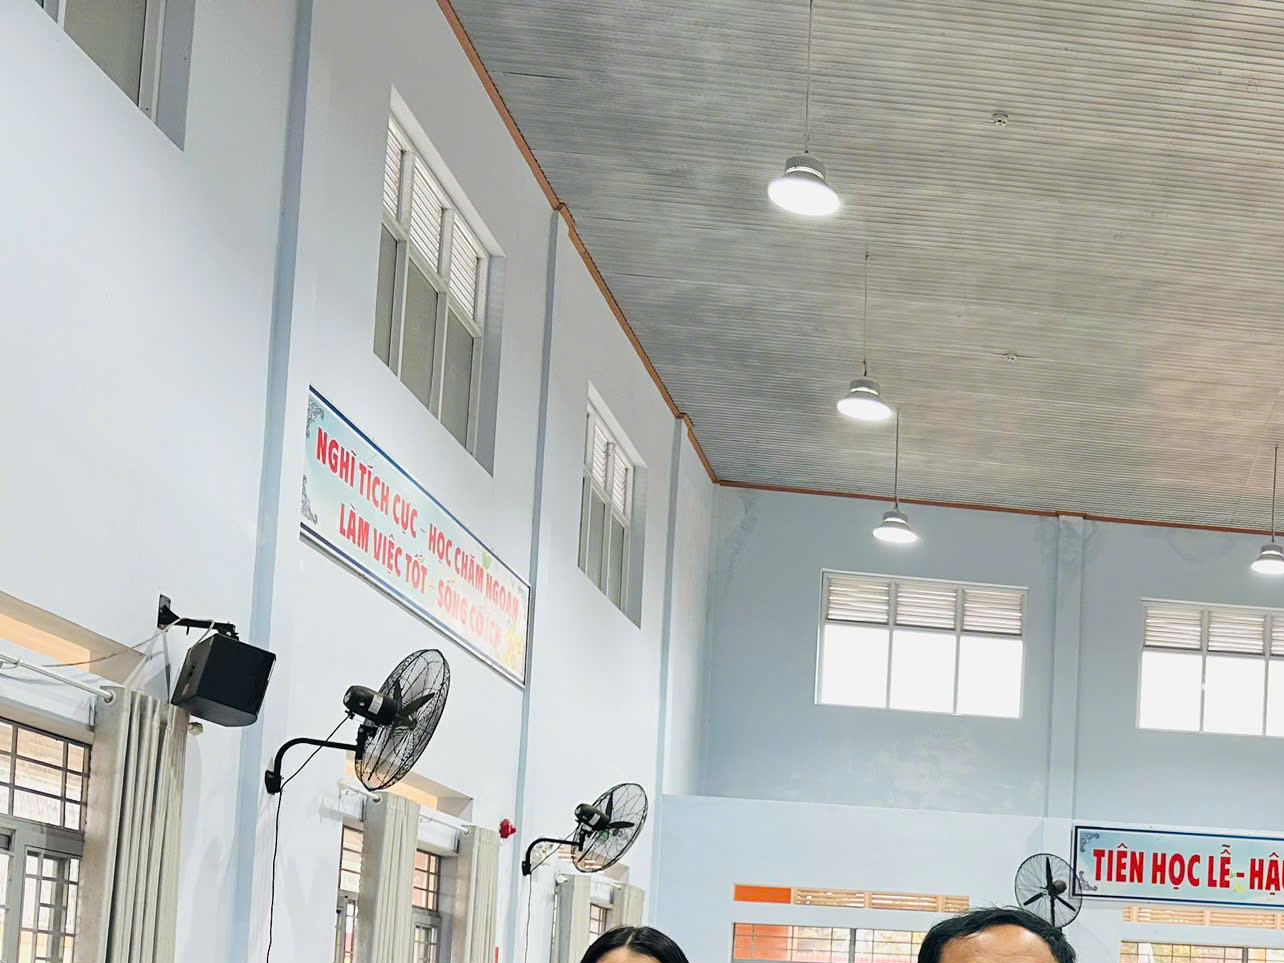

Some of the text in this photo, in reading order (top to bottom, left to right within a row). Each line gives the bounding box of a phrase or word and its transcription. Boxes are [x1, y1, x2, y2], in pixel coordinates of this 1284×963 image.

[339, 503, 369, 553] LÀM
[373, 528, 402, 577] VIỆC
[405, 552, 427, 594] TỐT
[359, 462, 389, 515] TÍCH
[428, 523, 452, 567] HỌC
[1092, 842, 1144, 884] TIÊN
[1151, 852, 1201, 890] HỌC
[1207, 843, 1232, 889] LỄ
